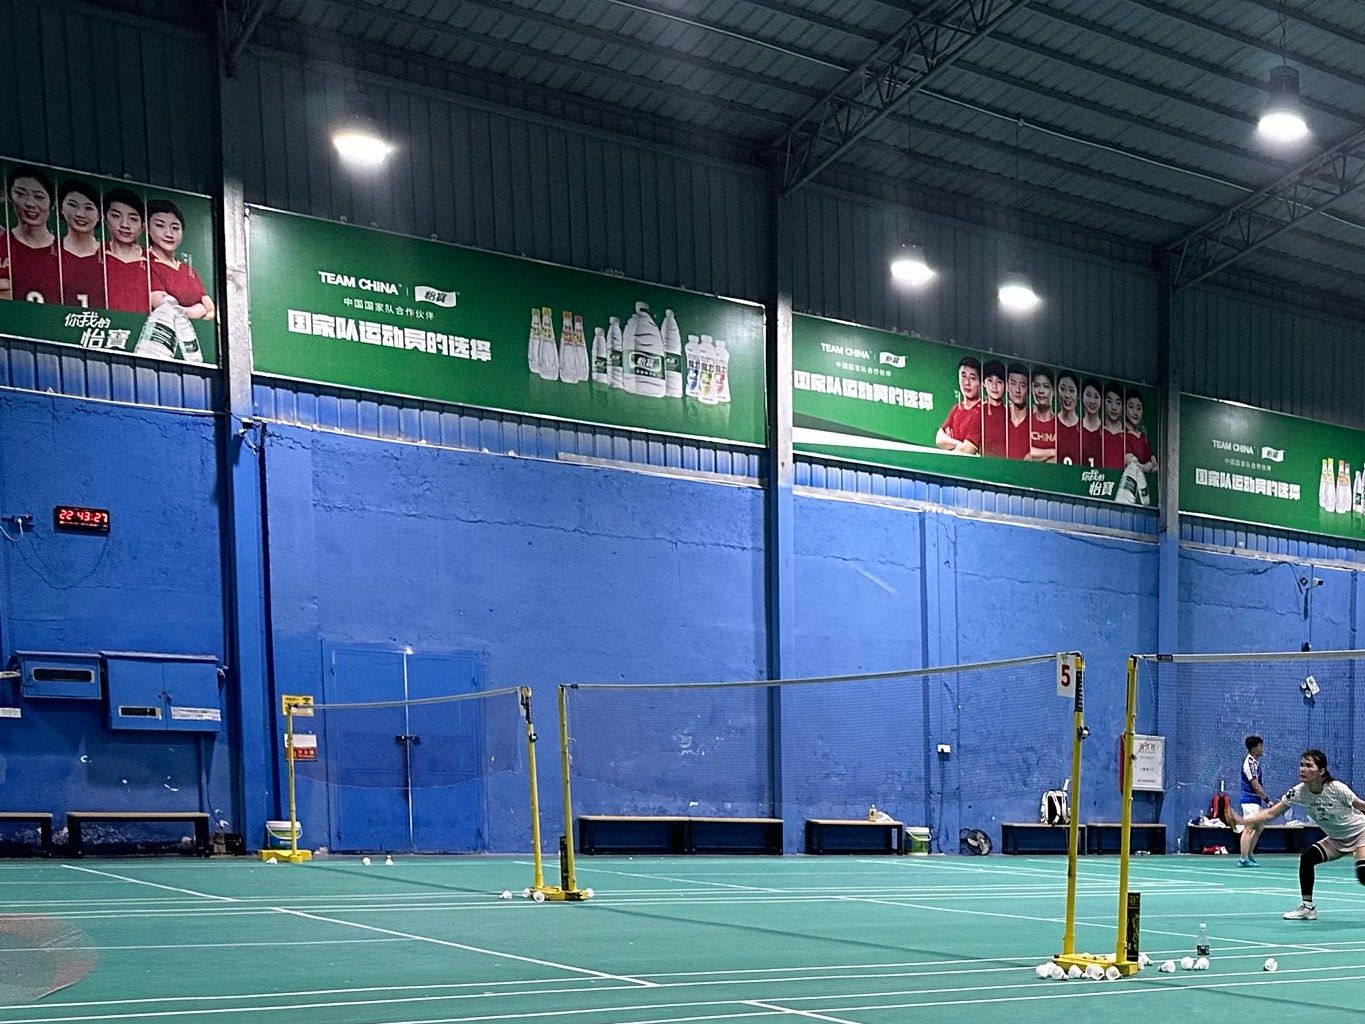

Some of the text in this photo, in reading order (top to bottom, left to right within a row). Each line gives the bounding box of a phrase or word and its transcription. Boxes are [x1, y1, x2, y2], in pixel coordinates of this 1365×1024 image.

[318, 270, 399, 295] TEAM CHINA
[64, 311, 111, 328] 你我的
[343, 297, 435, 321] 中国国家队合作伙伴
[287, 309, 492, 362] 国家队运动员的选择
[820, 342, 870, 359] TEAM CHINA
[1212, 439, 1232, 451] TEAM
[1232, 443, 1254, 455] CHINA
[1061, 664, 1071, 687] 5
